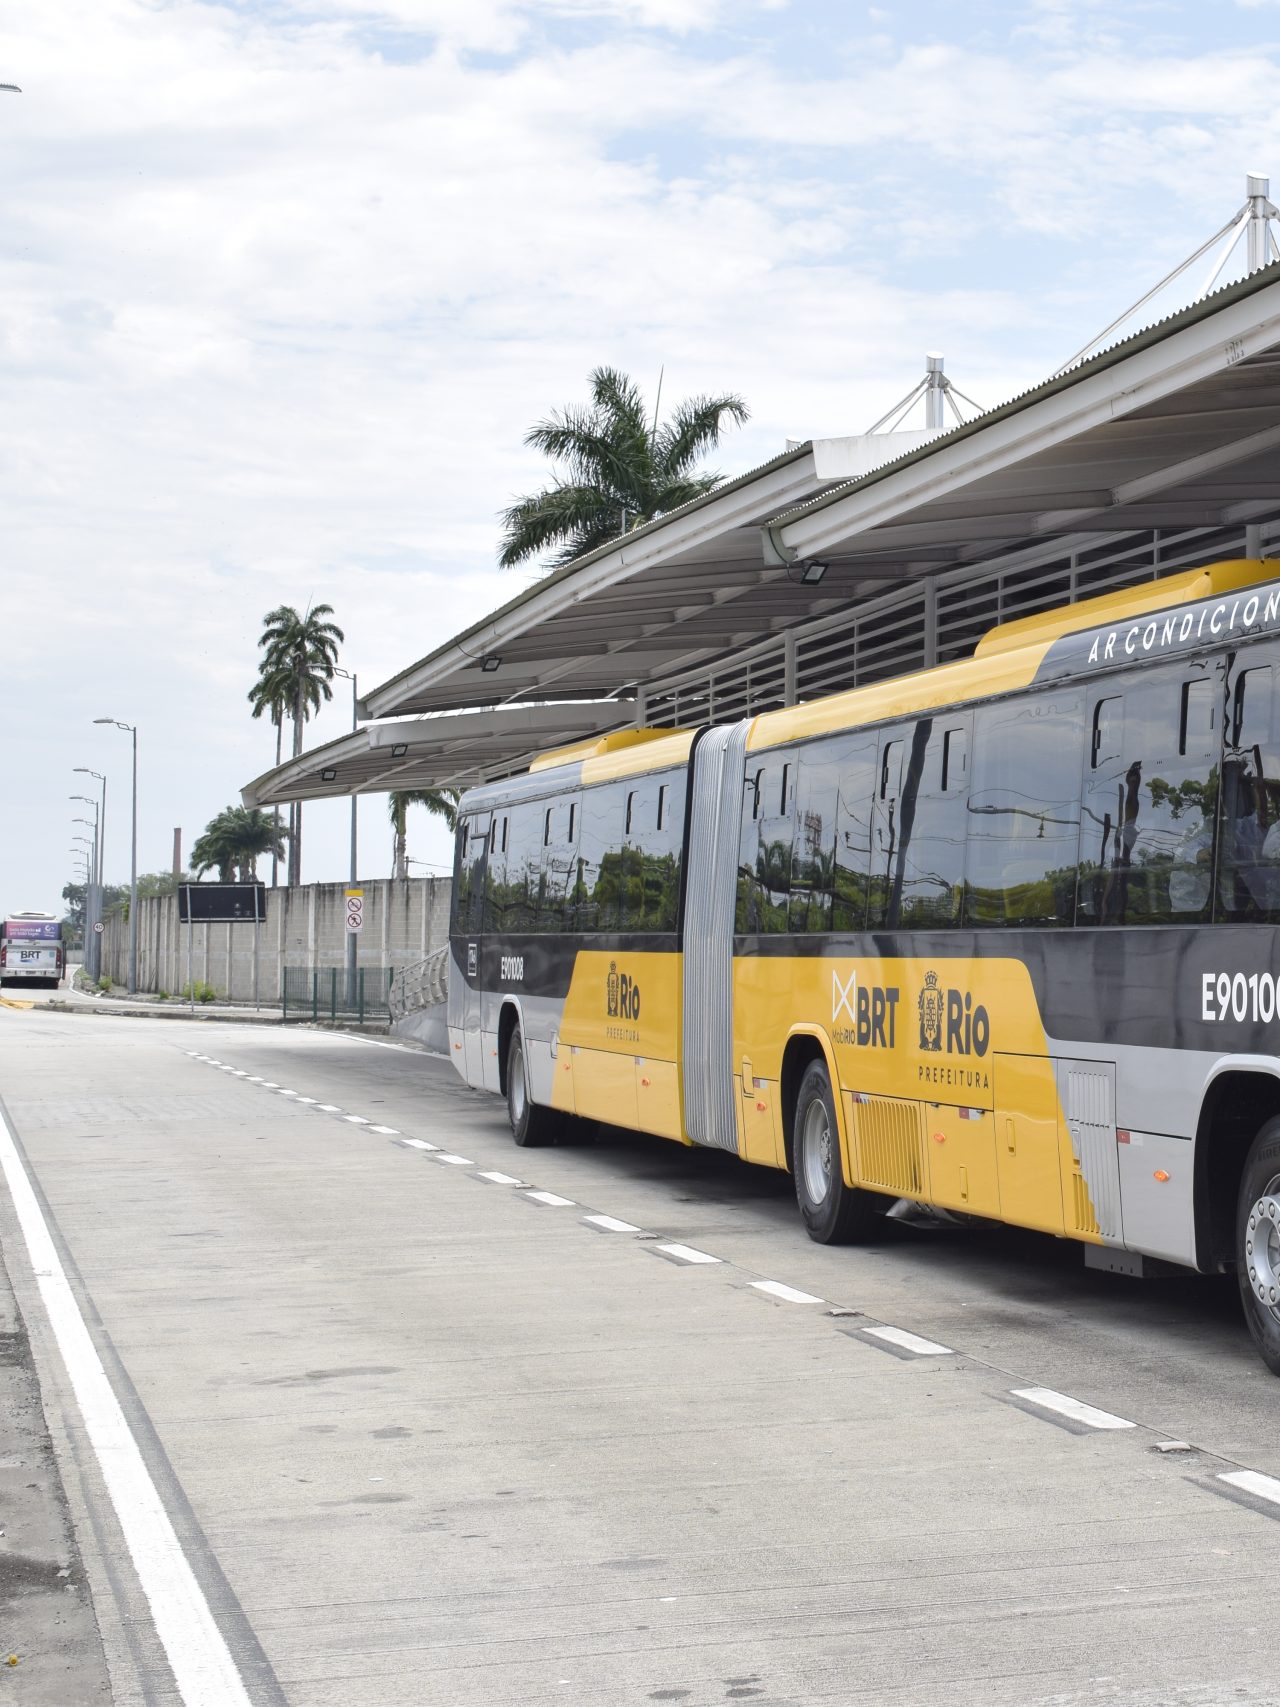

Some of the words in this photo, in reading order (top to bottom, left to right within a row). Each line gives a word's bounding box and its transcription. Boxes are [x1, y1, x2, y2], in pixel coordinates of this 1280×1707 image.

[1088, 632, 1117, 663] AR
[21, 951, 41, 959] BRT
[501, 956, 524, 980] E901008
[620, 973, 641, 1020] Rio
[856, 986, 900, 1049] BRT
[947, 989, 990, 1058] Rio
[606, 1026, 640, 1042] PREFEITURA
[832, 1029, 856, 1045] MobiRIO
[918, 1065, 989, 1089] PREFEITURA
